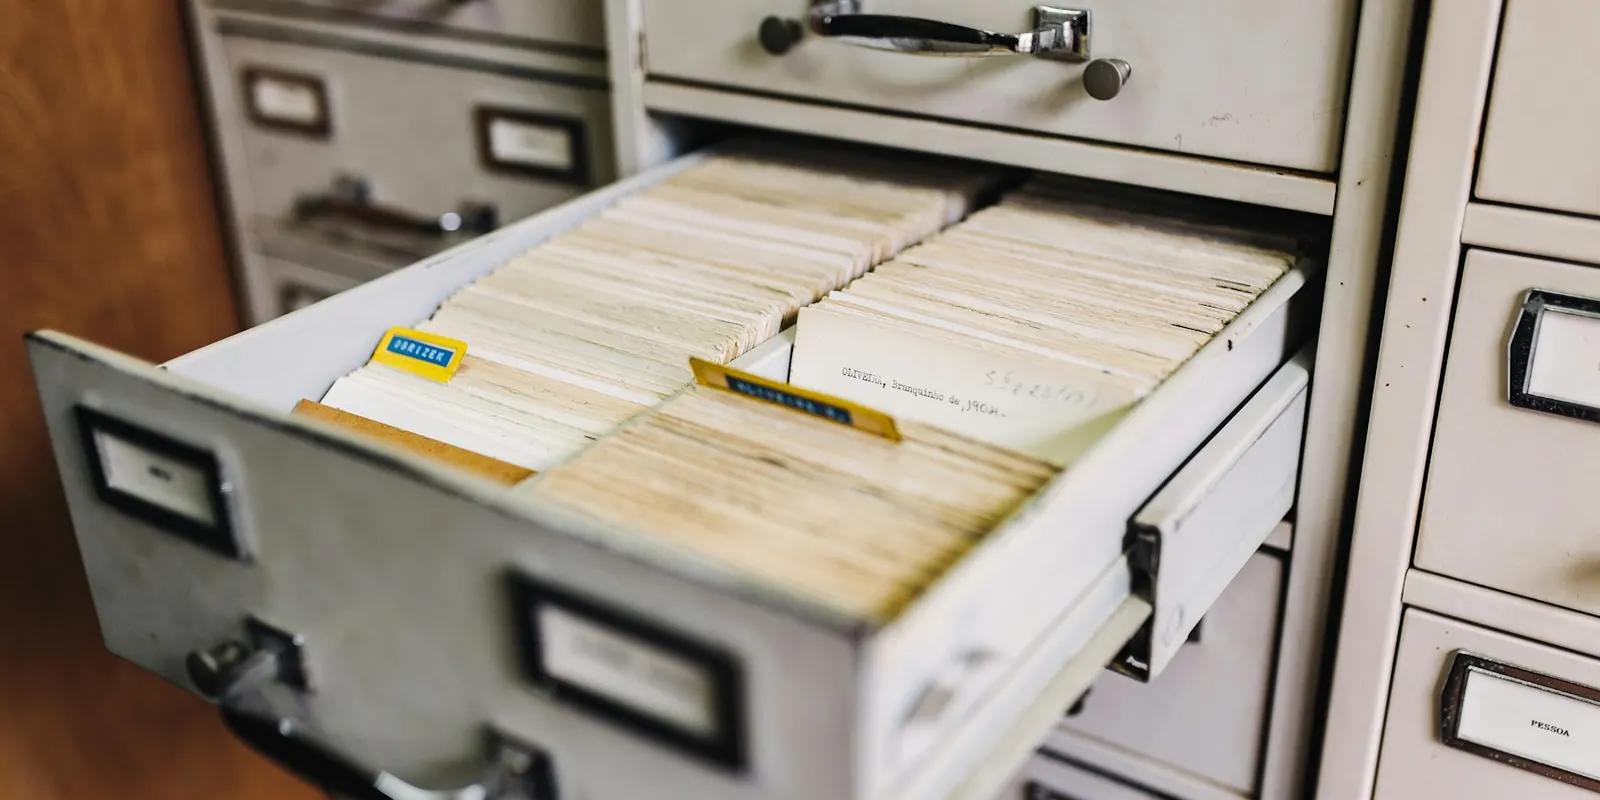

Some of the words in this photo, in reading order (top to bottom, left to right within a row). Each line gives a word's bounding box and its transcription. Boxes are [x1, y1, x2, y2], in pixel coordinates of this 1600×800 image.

[842, 367, 886, 388] OLIVEIRA,
[892, 380, 944, 401] Branquinho
[1531, 719, 1569, 737] PESSOA
